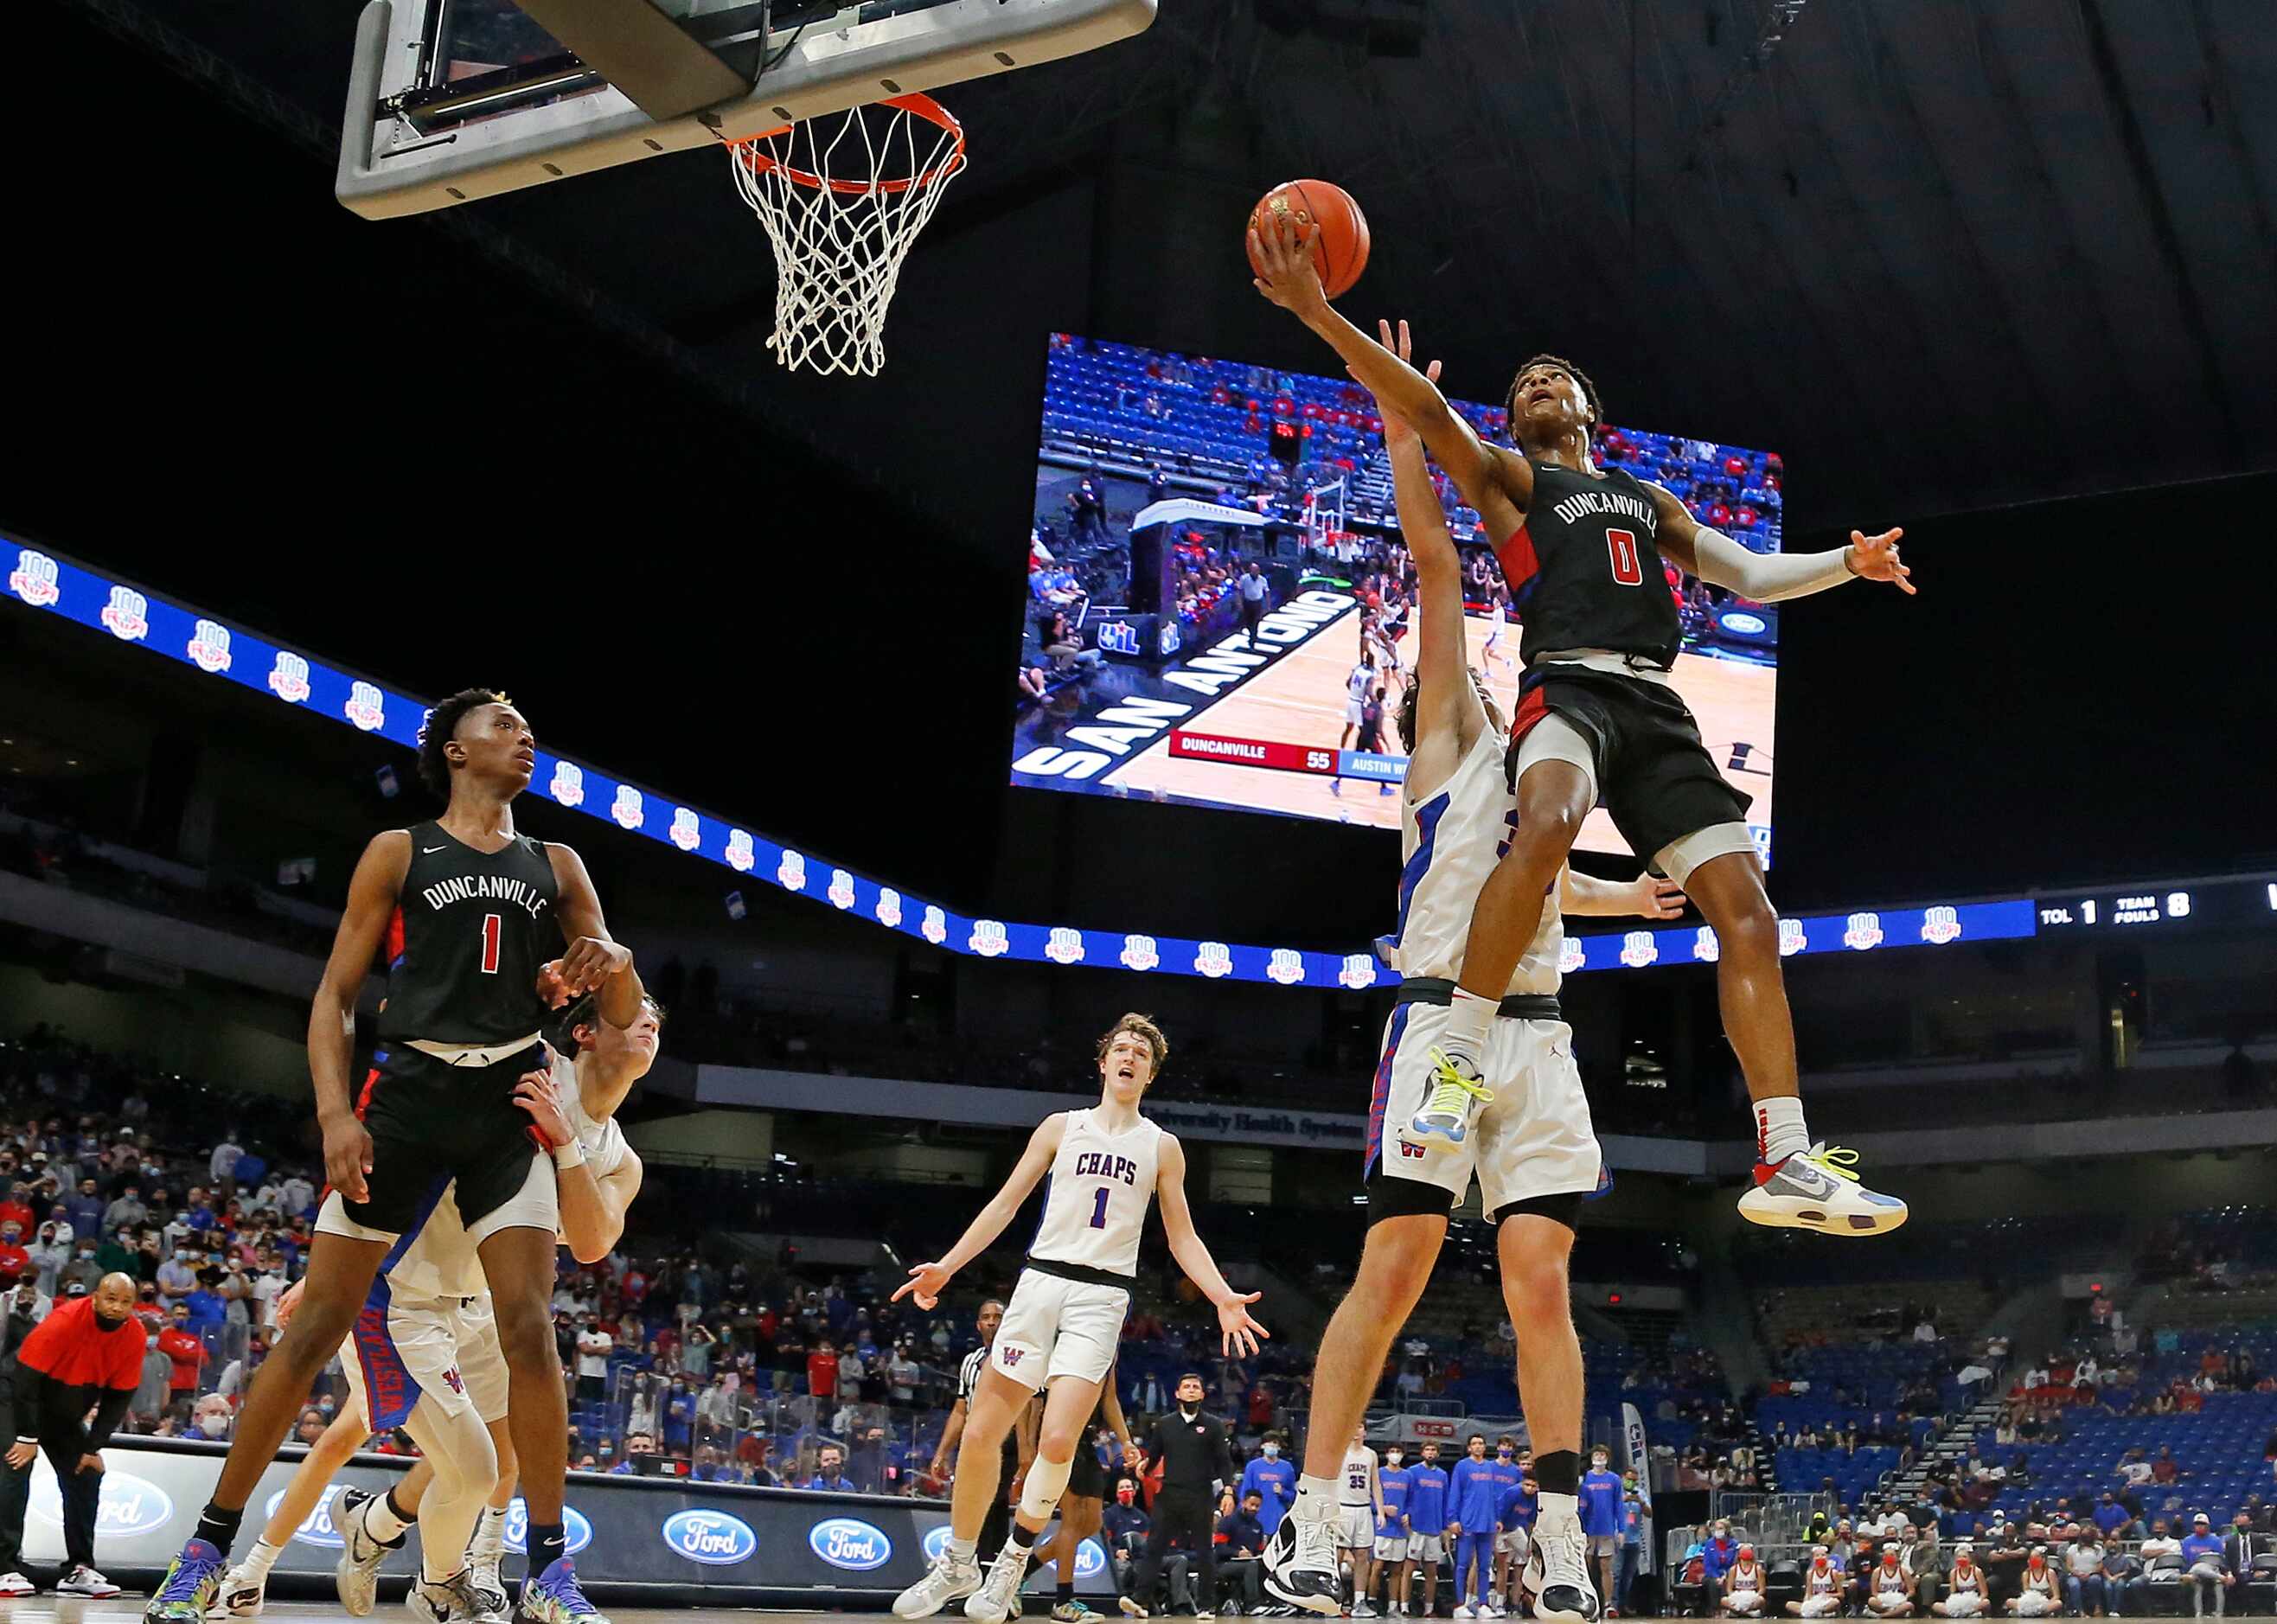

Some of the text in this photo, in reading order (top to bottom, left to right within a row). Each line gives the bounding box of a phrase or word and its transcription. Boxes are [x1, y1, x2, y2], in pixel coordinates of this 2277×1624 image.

[20, 551, 58, 583] 100
[1606, 527, 1643, 586] 0
[111, 586, 147, 617] 100
[1162, 591, 1357, 695] ANTONIO
[1011, 696, 1193, 780] SAN
[1181, 737, 1330, 770] DUNCANVILLE 55
[1352, 758, 1391, 774] AUSTIN
[423, 875, 547, 920] DUNCANVILLE
[2041, 899, 2097, 924] TOL 1
[2117, 896, 2155, 910] TEAM
[2167, 892, 2190, 917] 8
[975, 920, 1006, 938] 100
[1780, 919, 1803, 935] 00
[2114, 909, 2160, 924] FOULS
[481, 913, 501, 974] 1
[1050, 928, 1082, 946] 100
[1234, 1112, 1295, 1135] Health
[1300, 1117, 1364, 1140] System
[1075, 1152, 1137, 1186] CHAPS
[1089, 1186, 1110, 1230] 1
[1349, 1475, 1366, 1489] 35
[99, 1494, 143, 1524] rd
[682, 1518, 739, 1554] Ford
[827, 1526, 875, 1560] Ford
[1075, 1550, 1094, 1569] rd
